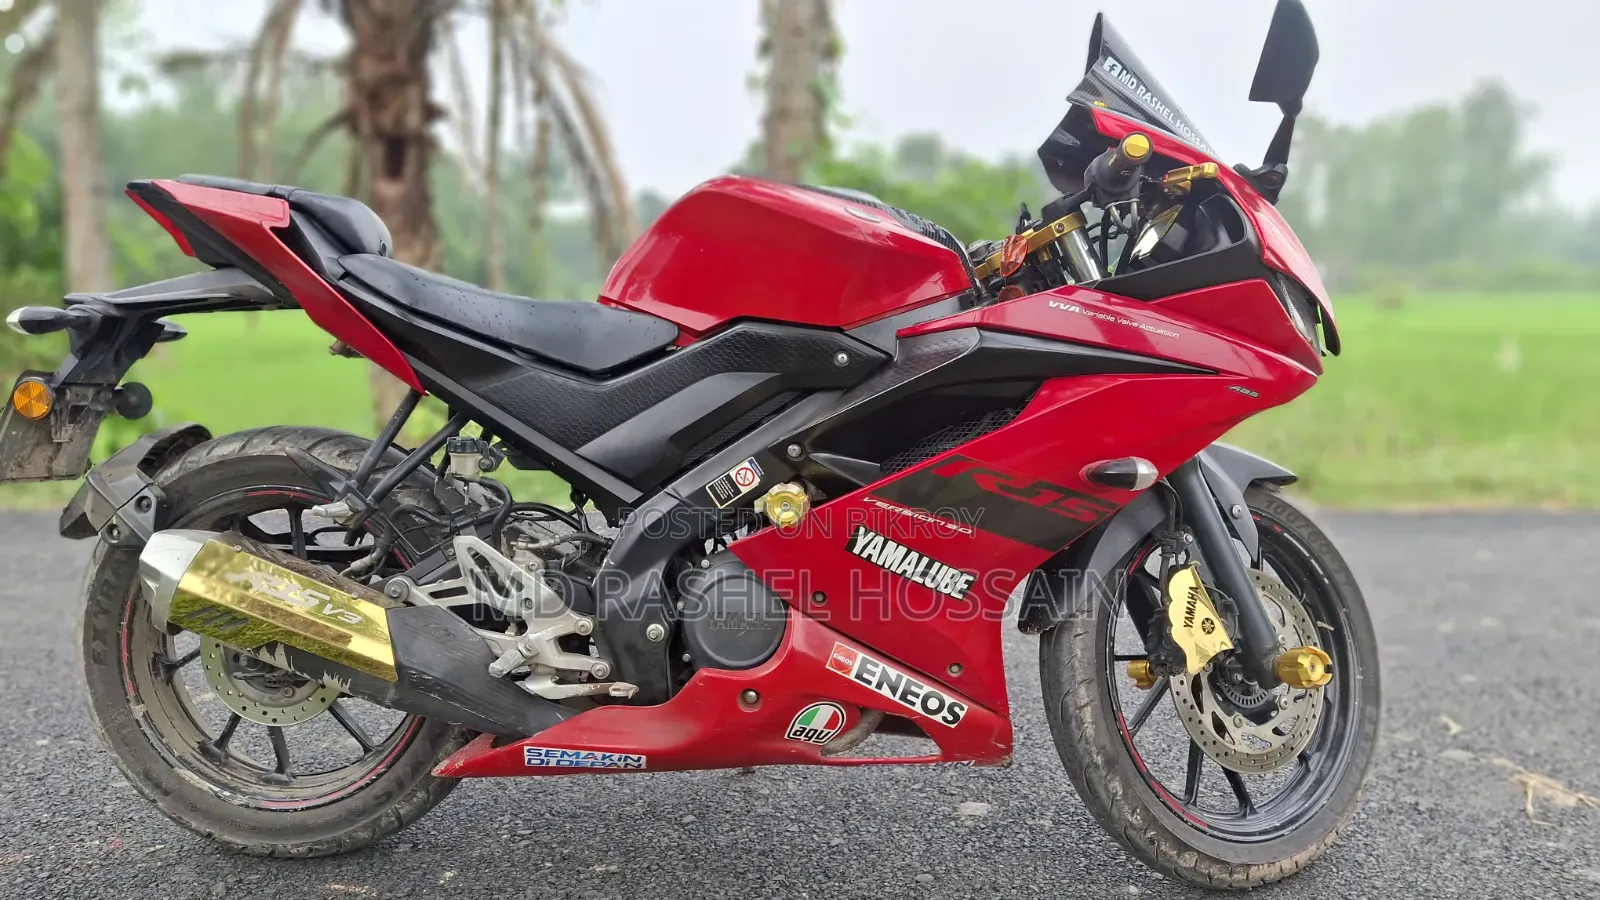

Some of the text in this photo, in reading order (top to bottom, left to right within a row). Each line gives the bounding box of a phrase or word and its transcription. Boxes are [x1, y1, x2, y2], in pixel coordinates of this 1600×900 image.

[1118, 69, 1137, 90] MD
[1136, 85, 1174, 123] RASHEL
[1049, 300, 1180, 338] VVA Variable Valve Actuation
[929, 460, 1114, 523] R15
[851, 526, 976, 600] YAMALUBE
[223, 571, 362, 625] R15 V3
[1183, 586, 1199, 628] YAMAHA
[832, 652, 965, 725] ENEOS ENEOS
[792, 725, 831, 742] agv
[555, 759, 642, 768] DEPAN
